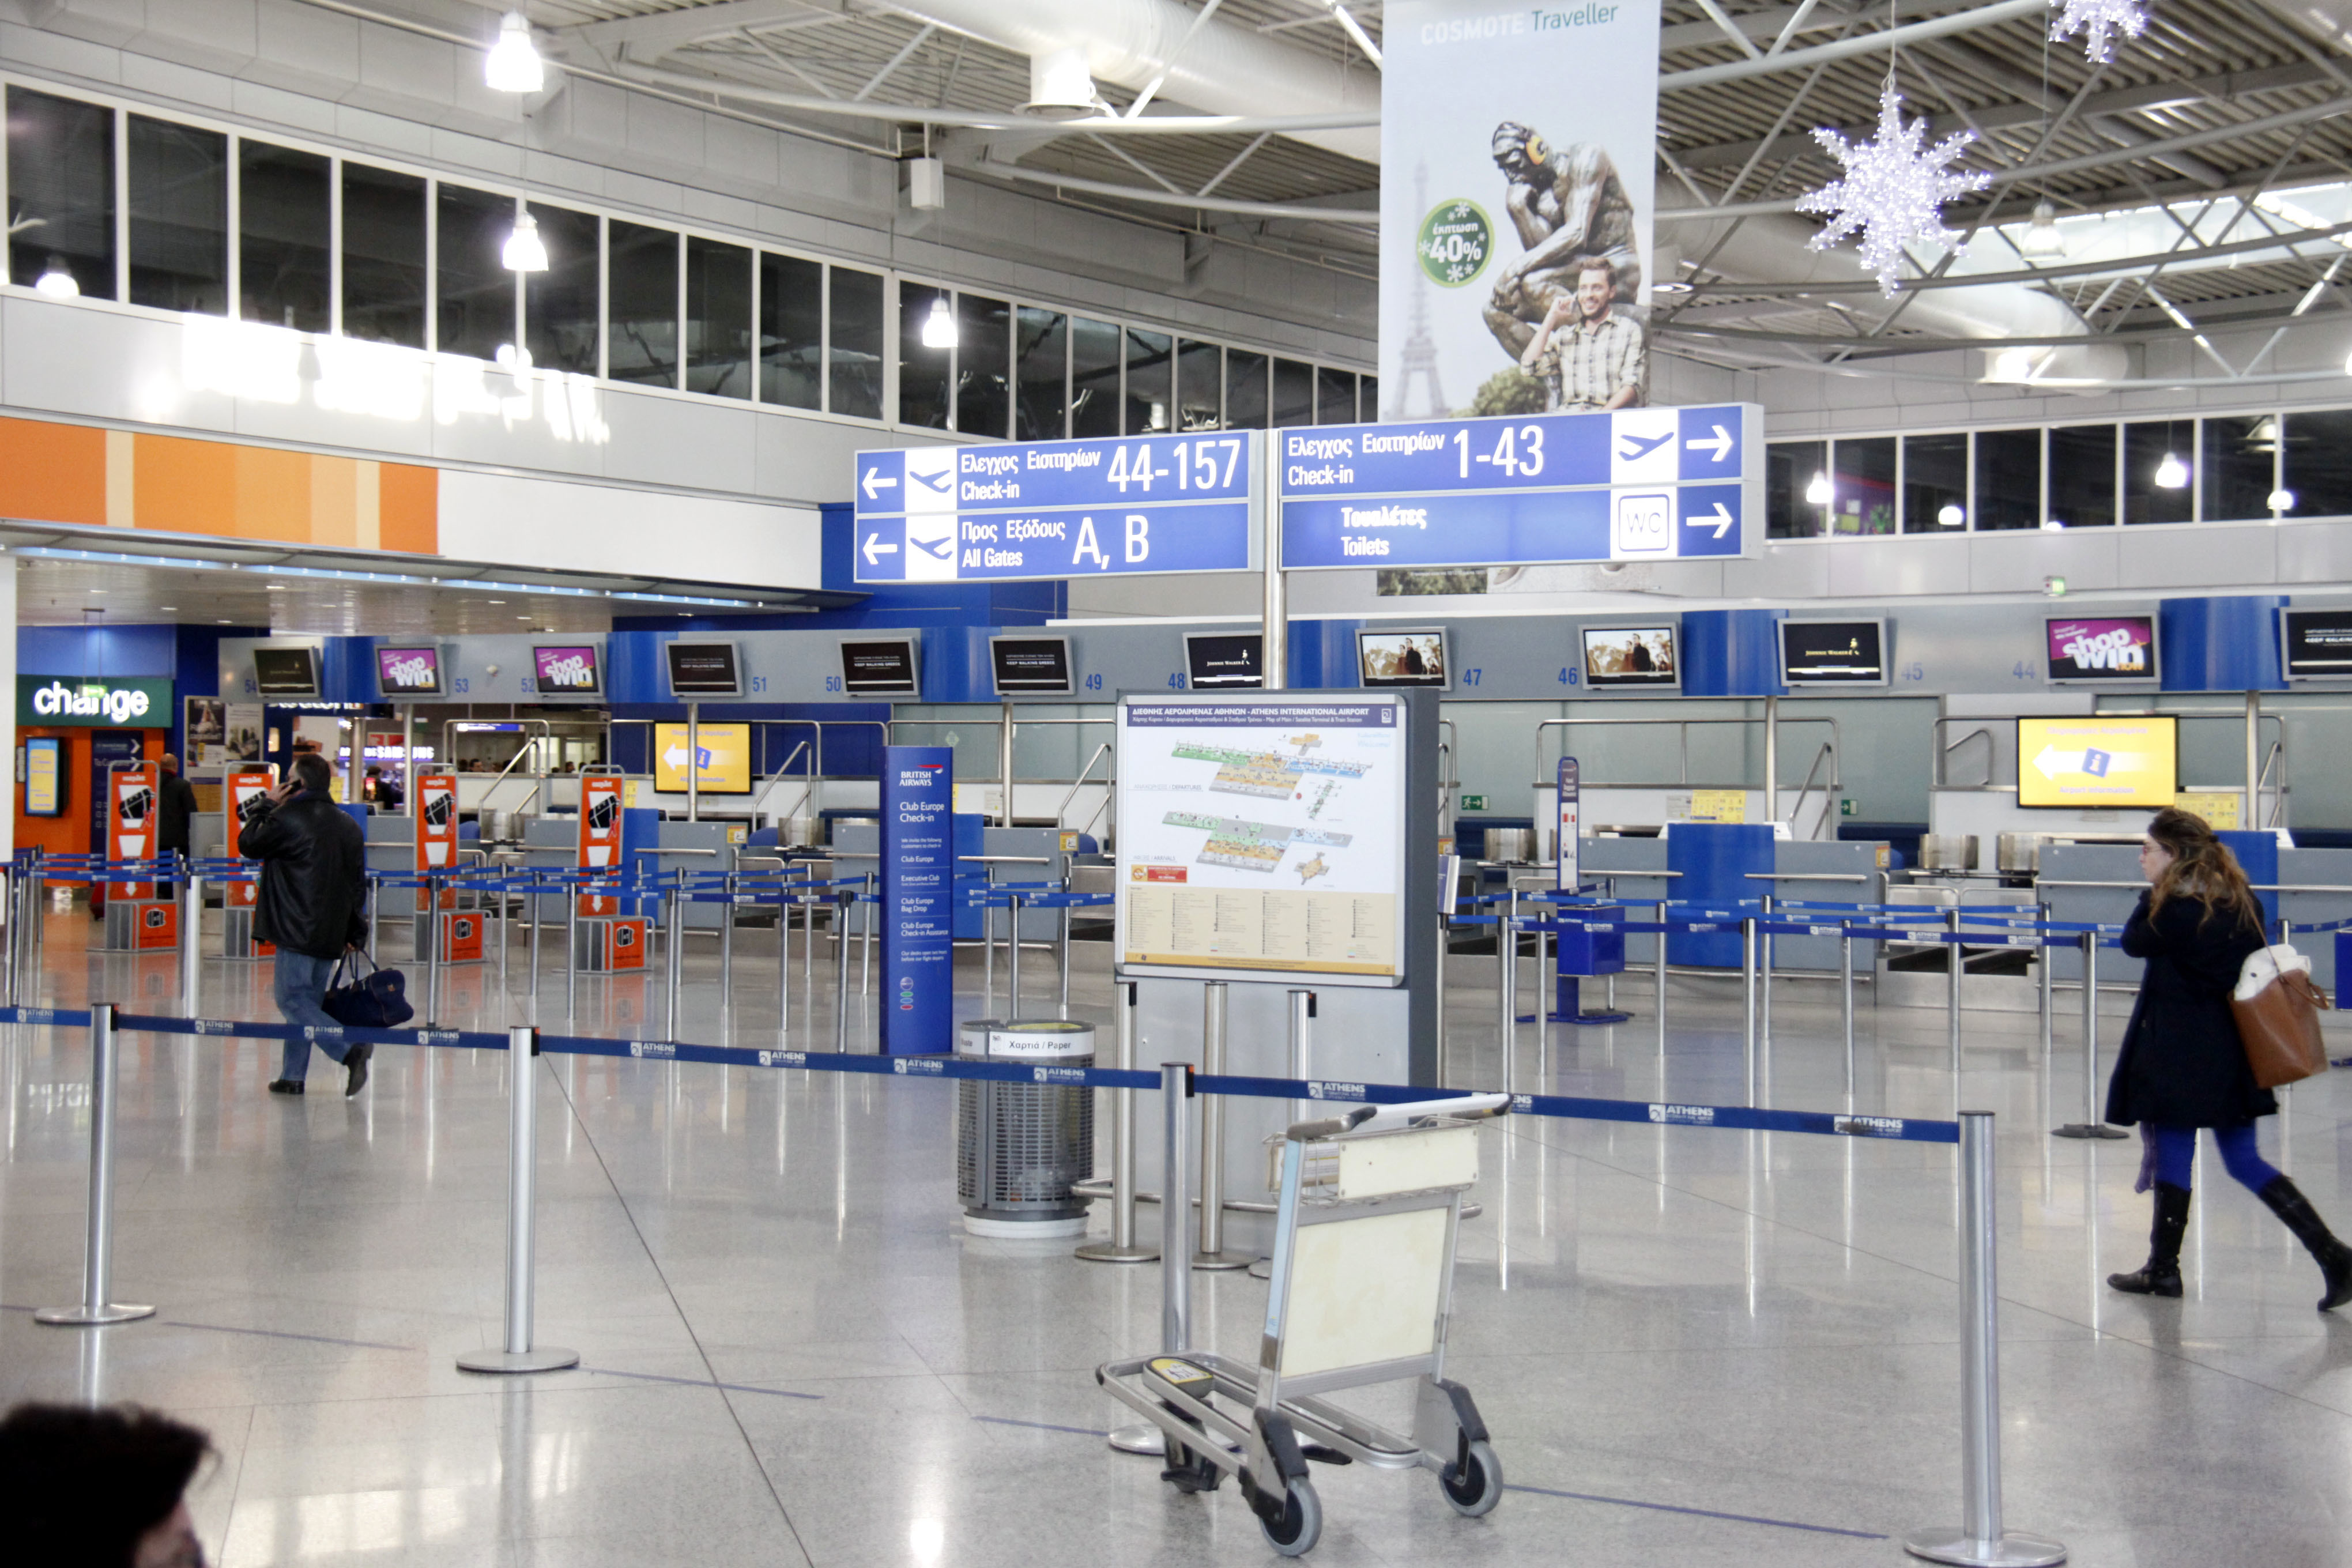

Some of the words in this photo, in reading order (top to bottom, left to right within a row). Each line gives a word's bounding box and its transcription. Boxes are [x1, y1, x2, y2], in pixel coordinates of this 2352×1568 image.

[1421, 13, 1525, 45] COSMOTE
[1532, 3, 1618, 32] Traveller
[1429, 235, 1482, 263] 40%
[1288, 436, 1352, 459] Ελεγχος
[1362, 431, 1445, 455] Εισιτηρίων
[1453, 424, 1544, 478] 1-43
[961, 454, 1019, 475] Ελεγχος
[1027, 448, 1101, 472] Εισιτηρίων
[1107, 439, 1241, 493] 44-157
[1288, 465, 1354, 486] Check-in
[961, 480, 1020, 501] Check-in
[1341, 505, 1427, 530] Τουαλέτες
[1627, 511, 1661, 534] WC
[962, 521, 998, 542] Προς
[1006, 517, 1065, 539] Εξόδους
[1125, 515, 1149, 563] B
[1341, 536, 1389, 557] Toilets
[962, 549, 981, 567] All
[984, 547, 1023, 568] Gates
[2062, 628, 2131, 657] shop
[545, 655, 583, 676] shop
[2073, 644, 2145, 669] win
[389, 657, 425, 677] shop
[552, 667, 593, 685] win
[1558, 667, 1578, 685] 46
[1902, 662, 1924, 681] 45
[2012, 661, 2036, 679] 44
[395, 669, 435, 686] win
[455, 678, 469, 693] 53
[521, 677, 535, 692] 52
[752, 676, 767, 692] 51
[826, 676, 841, 692] 50
[1085, 673, 1102, 690] 49
[1168, 673, 1185, 689] 48
[1463, 669, 1482, 686] 47
[34, 681, 149, 722] change
[900, 802, 919, 811] Club
[920, 802, 945, 812] Europe
[900, 813, 934, 822] Check-in
[206, 1020, 234, 1028] ATHENS
[642, 1042, 676, 1052] ATHENS
[1009, 1040, 1039, 1050] Χαρτιά
[1047, 1041, 1072, 1050] Paper
[772, 1051, 806, 1060] ATHENS
[907, 1059, 943, 1068] ATHENS
[1048, 1068, 1085, 1077] ATHENS
[1324, 1083, 1366, 1092] ATHENS
[1666, 1105, 1714, 1116] ATHENS
[1853, 1117, 1903, 1129] ATHENS
